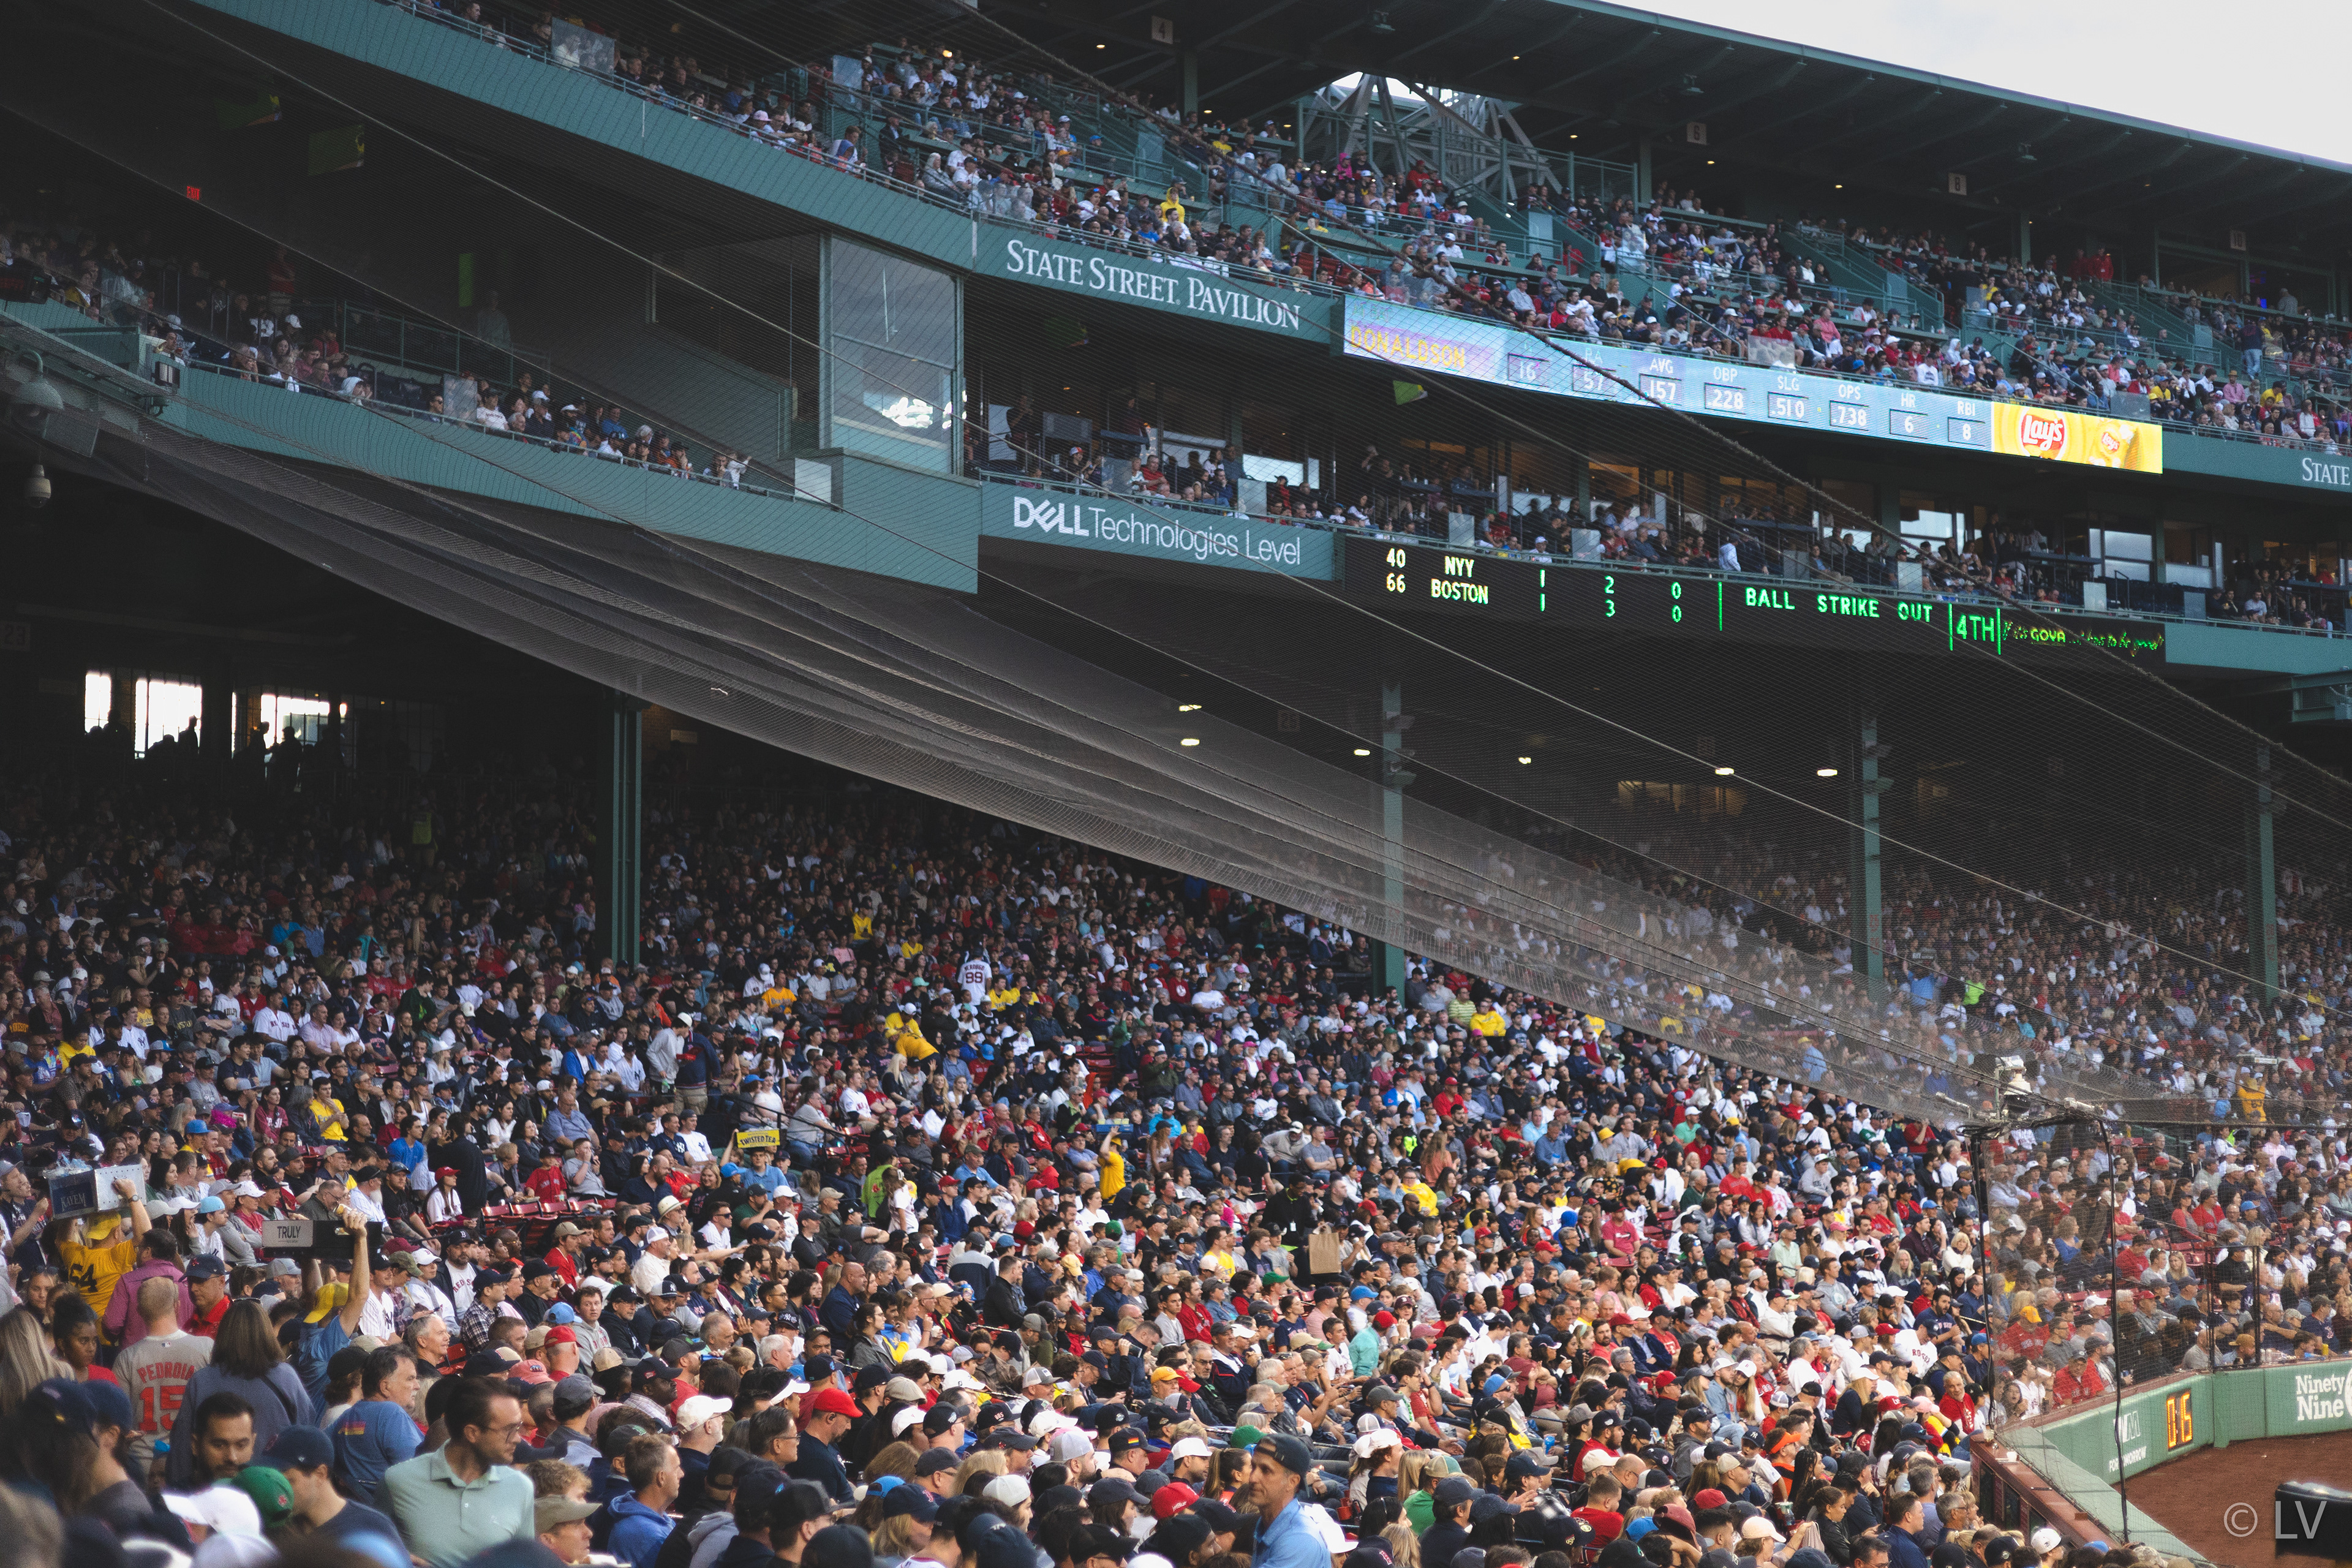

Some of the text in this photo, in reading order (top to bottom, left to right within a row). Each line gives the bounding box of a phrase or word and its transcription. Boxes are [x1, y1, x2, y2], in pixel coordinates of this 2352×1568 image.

[1006, 239, 1300, 330] STATE STREET PAVILION
[1351, 325, 1466, 368] DONALDSON
[1649, 357, 1674, 374] AVG
[1713, 366, 1738, 383] OBP
[1777, 375, 1800, 391] SLG
[1838, 383, 1861, 400] OPS
[1901, 392, 1917, 409] HR
[1957, 400, 1976, 417] RBI
[1904, 415, 1914, 433] 6
[1962, 423, 1972, 441] 8
[2022, 415, 2064, 451] Lay's
[2302, 458, 2351, 486] STATE
[1014, 497, 1300, 565] DELL Technologies Level
[1386, 548, 1682, 600] 40 NYY 1 2 0
[1386, 573, 1682, 623] 66 BOSTON 1 3 0
[1745, 586, 1932, 622] BALL STRIKE OUT
[1956, 614, 1995, 643] 4TH
[965, 971, 984, 984] 99
[740, 1135, 776, 1146] TWISTED TEA
[277, 1226, 301, 1238] TRULY
[69, 1263, 98, 1294] 54
[137, 1362, 195, 1384] PEDROIA
[2296, 1373, 2345, 1395] Ninety
[138, 1385, 186, 1432] 15
[2297, 1394, 2345, 1421] Nine
[1171, 1500, 1188, 1512] jetBlue
